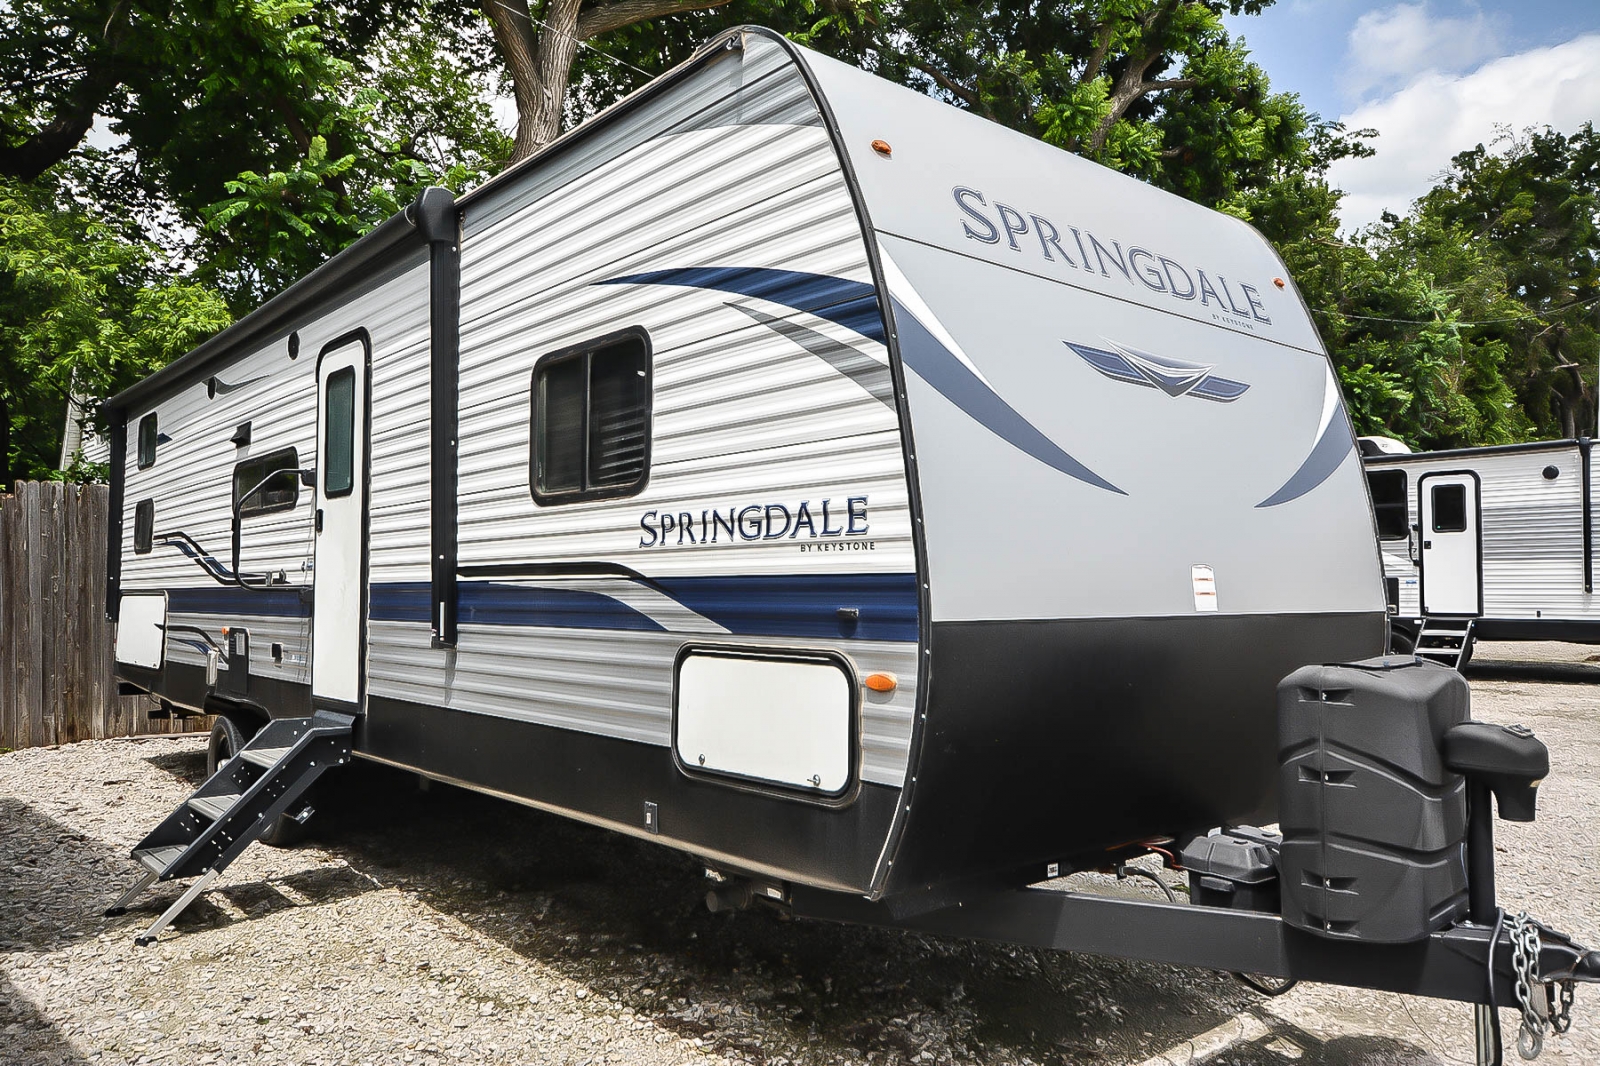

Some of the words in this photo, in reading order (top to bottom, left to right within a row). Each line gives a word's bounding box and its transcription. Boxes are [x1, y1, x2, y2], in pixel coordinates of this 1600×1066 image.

[952, 185, 1272, 326] SPRINGDALE
[1211, 313, 1220, 321] BY
[1221, 316, 1254, 331] KEYSTONE
[639, 495, 870, 548] SPRINGDALE
[800, 543, 813, 553] BY
[817, 541, 876, 552] KEYSTONE
